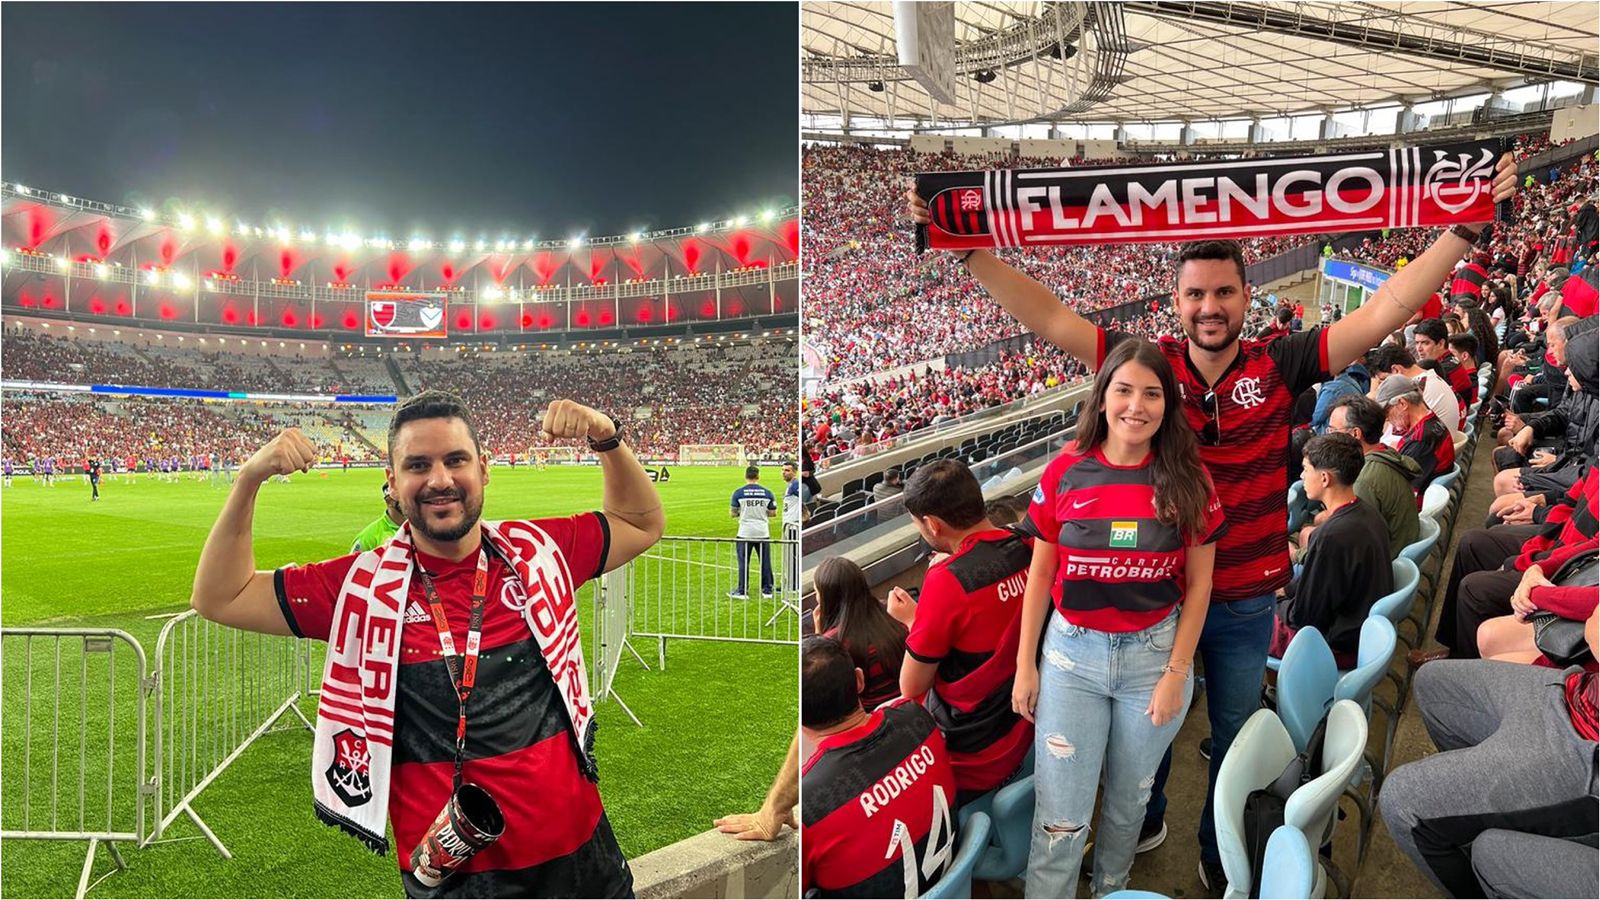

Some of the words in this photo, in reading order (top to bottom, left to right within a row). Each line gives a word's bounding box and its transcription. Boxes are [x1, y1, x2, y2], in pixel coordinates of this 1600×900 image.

[1016, 166, 1386, 232] FLAMENGO
[746, 499, 764, 507] BEPE
[1112, 530, 1136, 542] BR
[403, 614, 432, 624] didas
[859, 745, 935, 818] RODRIGO
[884, 784, 956, 899] 14
